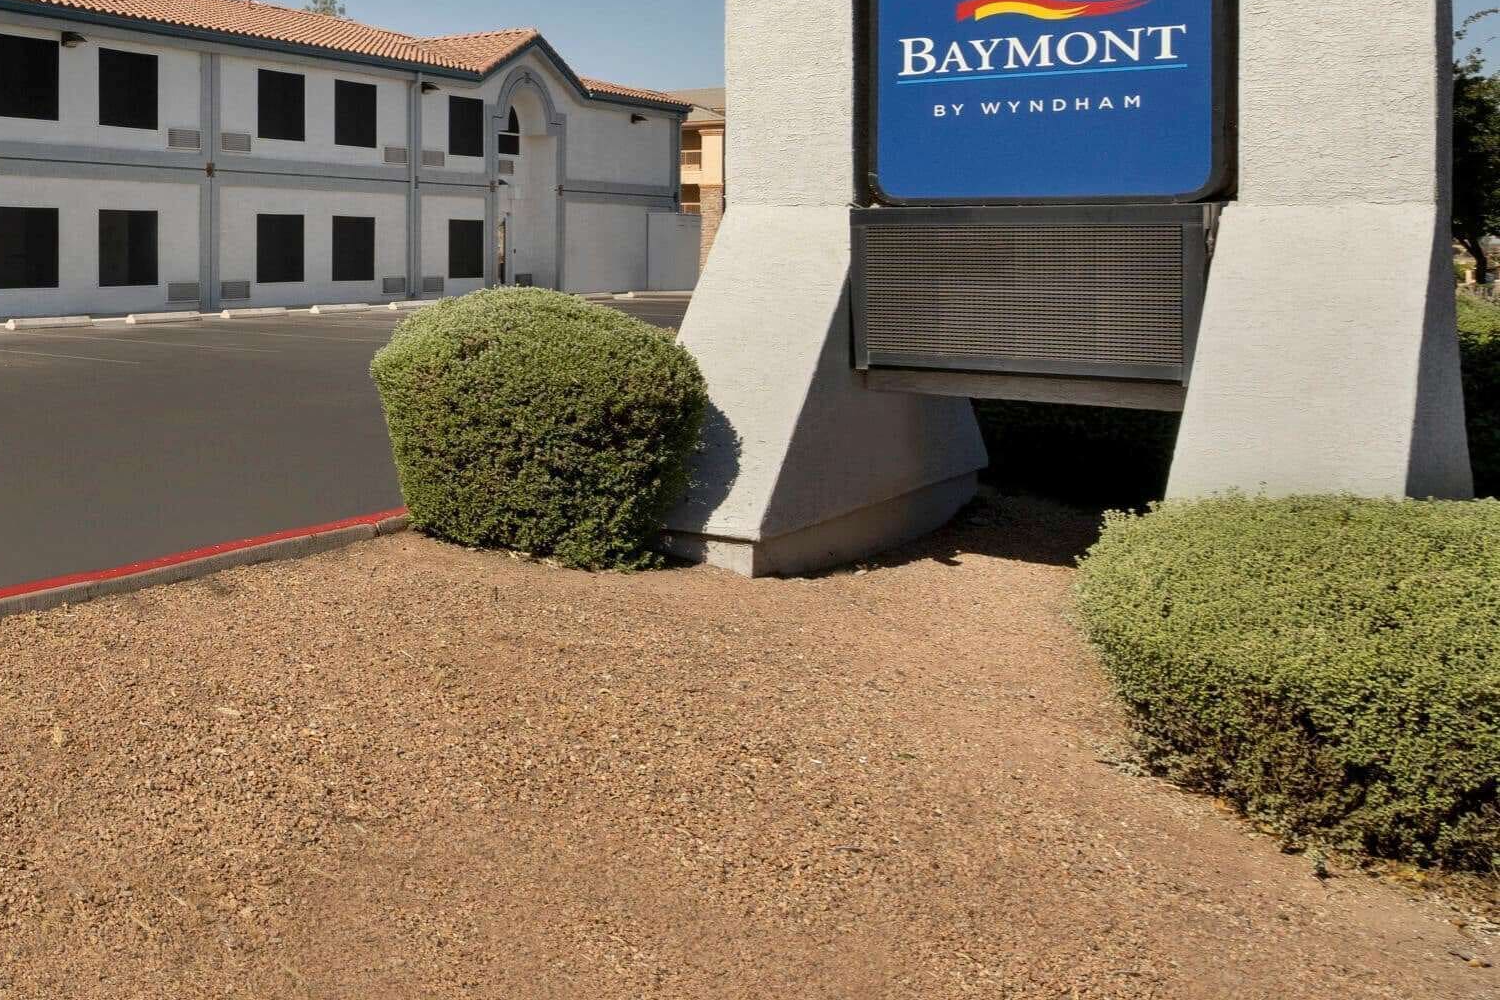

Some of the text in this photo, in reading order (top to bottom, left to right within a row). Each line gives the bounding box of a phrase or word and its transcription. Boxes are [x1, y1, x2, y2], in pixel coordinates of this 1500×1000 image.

[898, 24, 1186, 76] BAYMONT
[934, 95, 1141, 117] BY WYNDHAM
